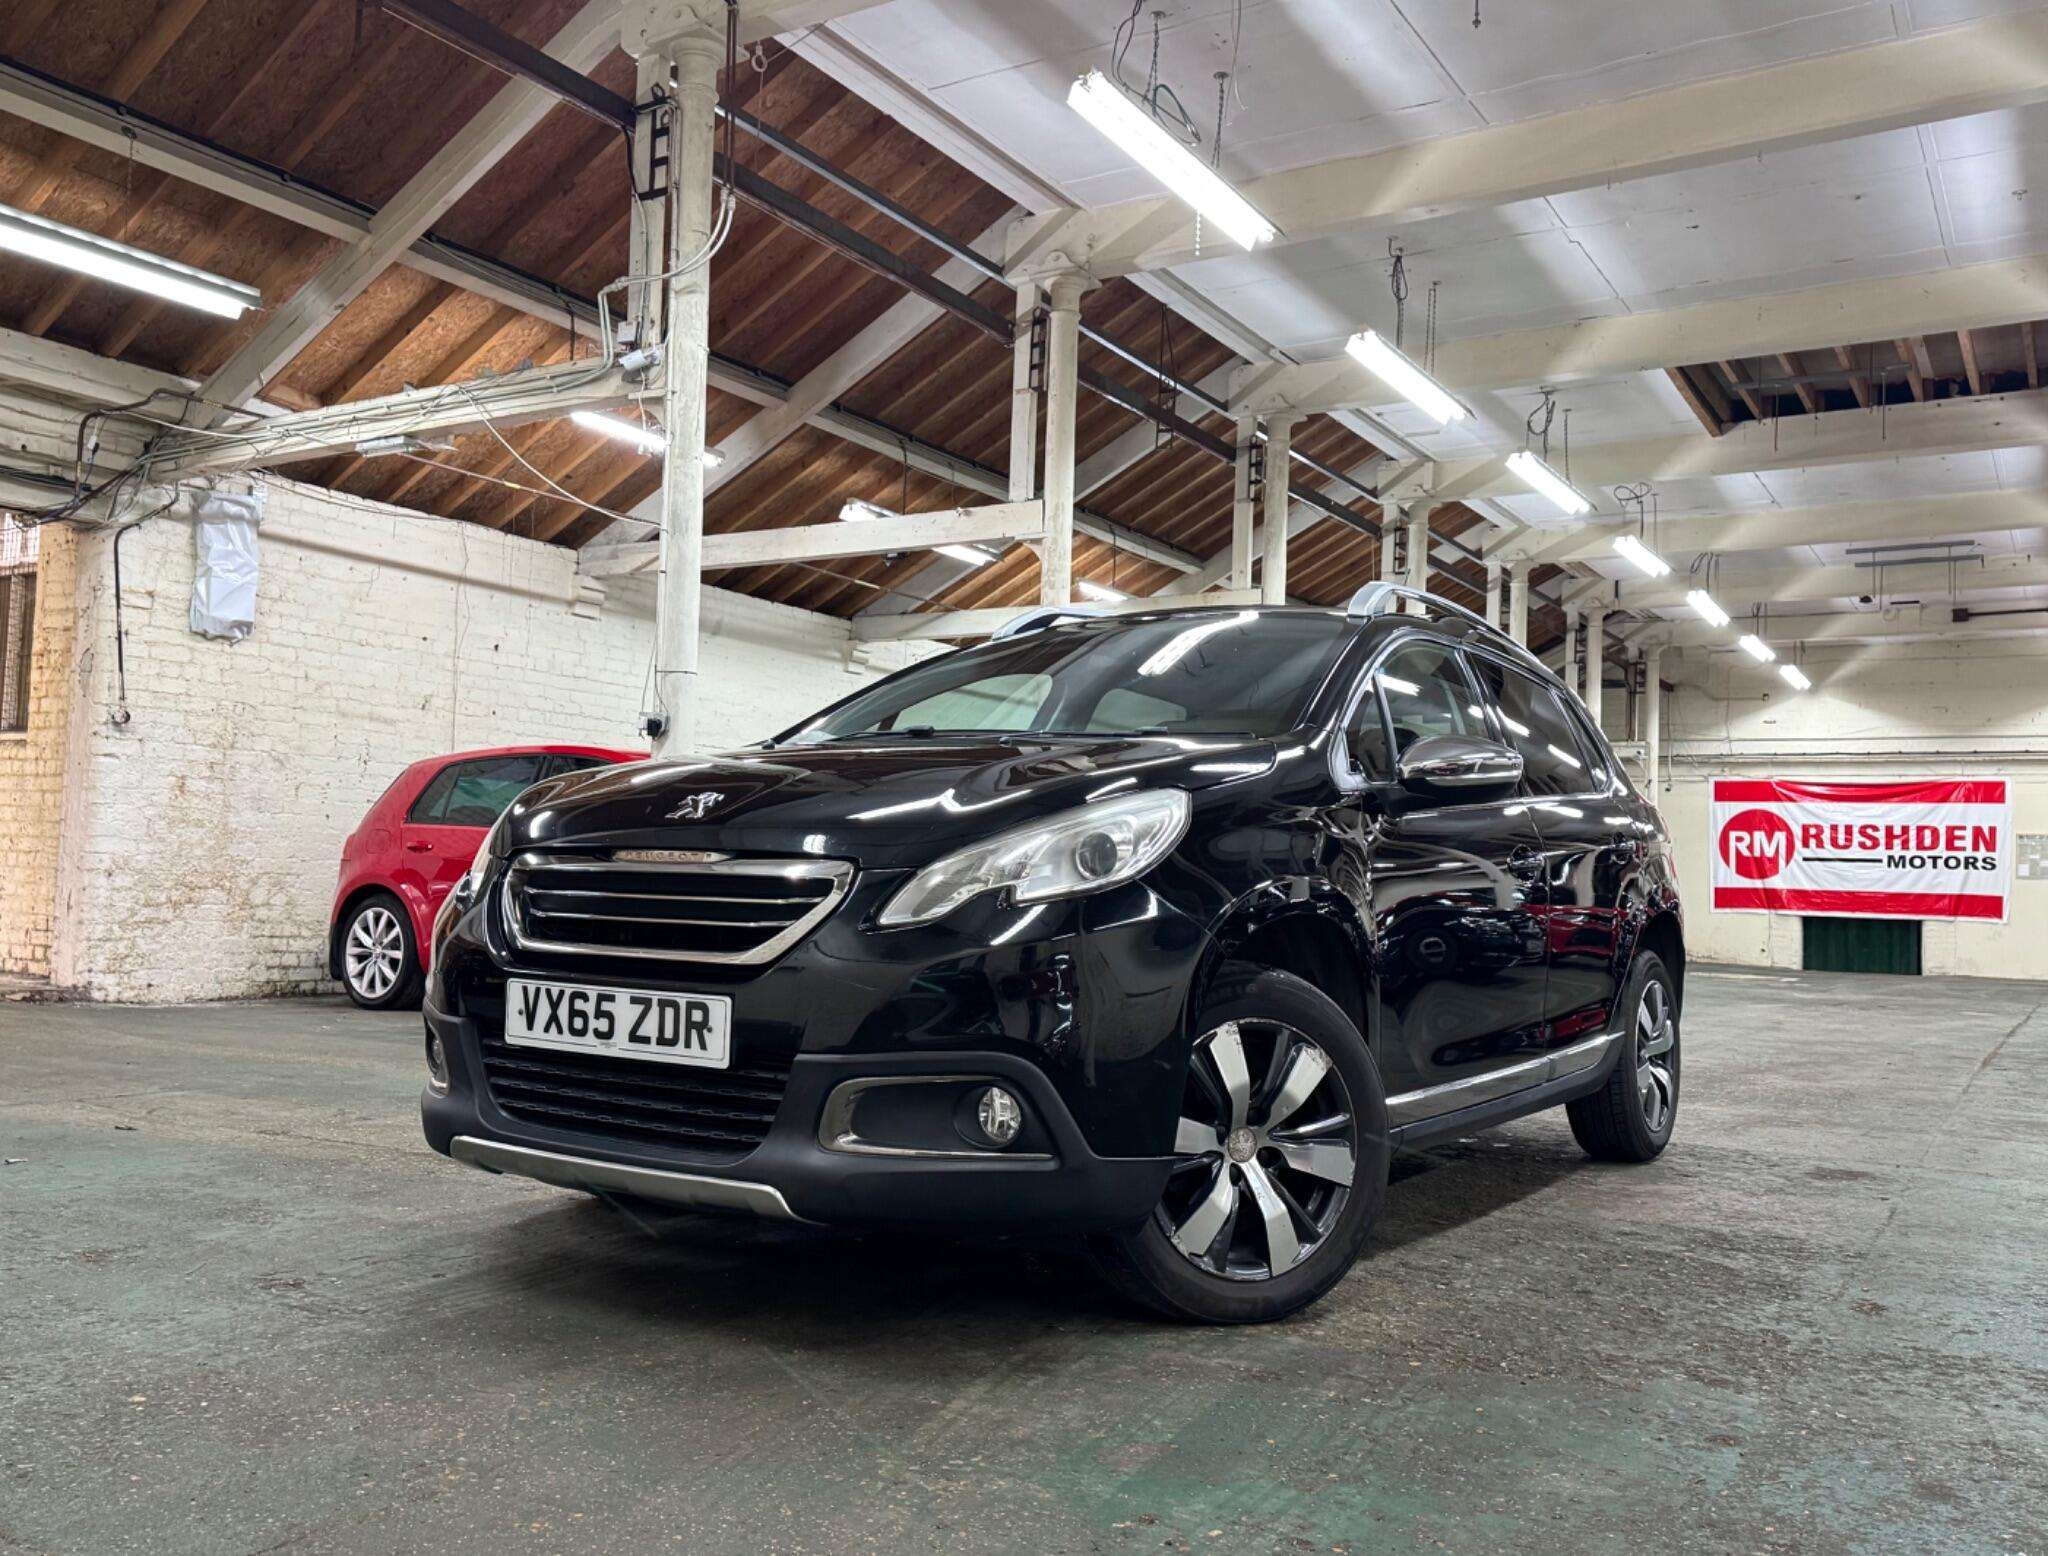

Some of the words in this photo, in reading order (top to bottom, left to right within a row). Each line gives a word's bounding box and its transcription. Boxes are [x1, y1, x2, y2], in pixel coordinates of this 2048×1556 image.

[1729, 830, 1787, 871] RM
[1801, 823, 1997, 852] RUSHDEN
[1886, 855, 1997, 871] MOTORS
[521, 985, 617, 1040] VX65
[627, 995, 712, 1051] ZDR
